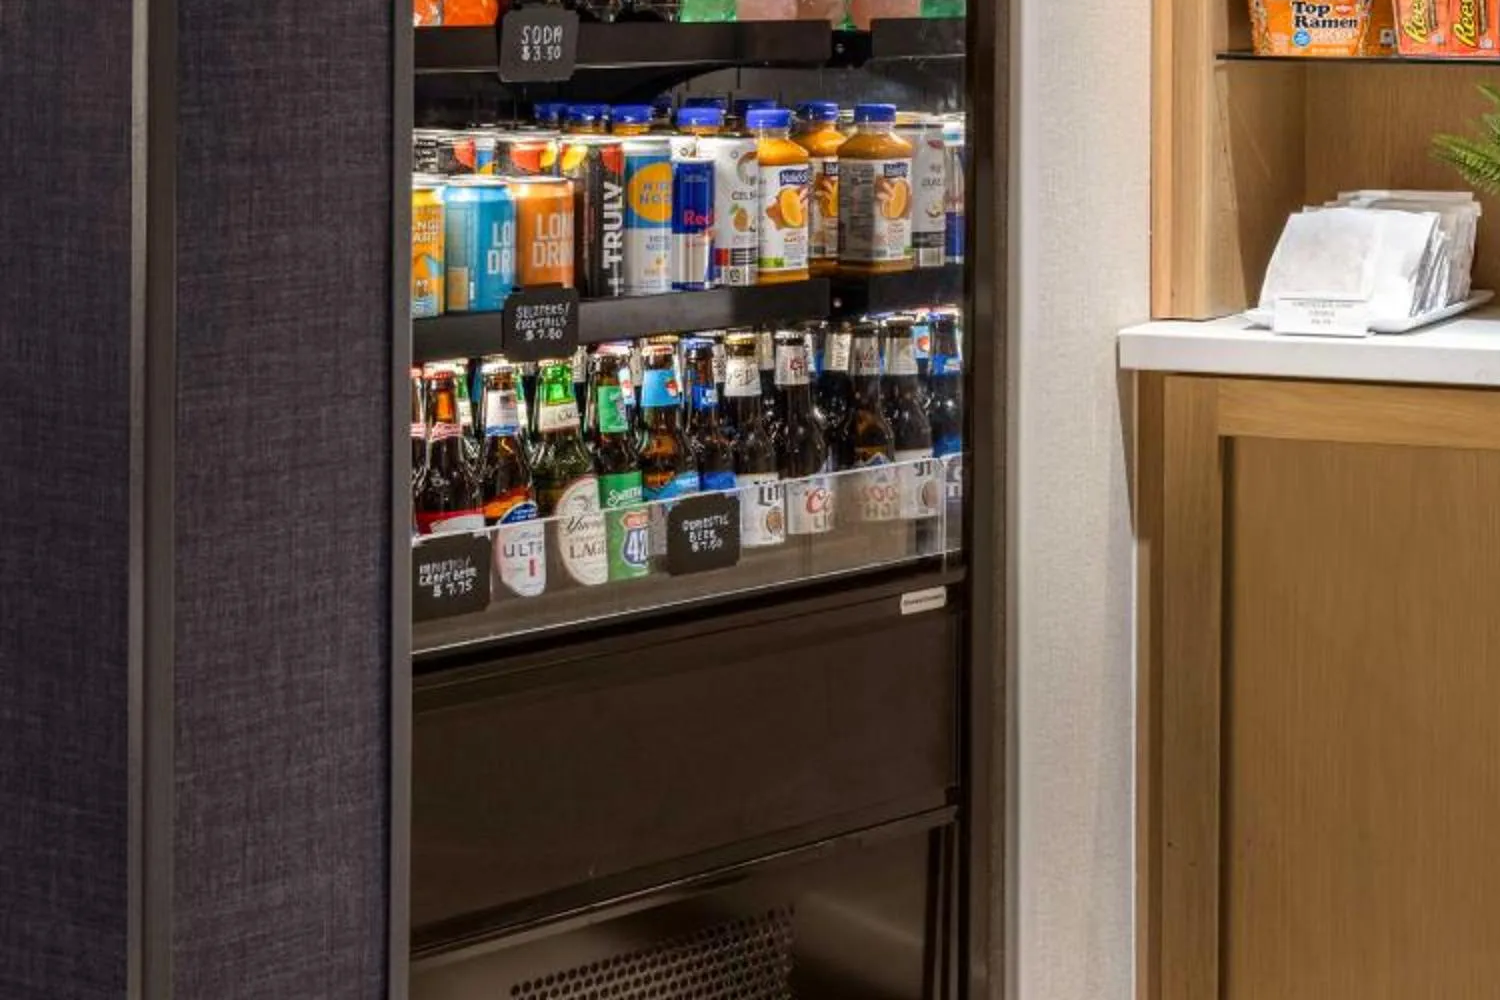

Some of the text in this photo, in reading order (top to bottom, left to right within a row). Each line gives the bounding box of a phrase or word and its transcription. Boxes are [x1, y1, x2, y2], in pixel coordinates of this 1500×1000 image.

[1292, 1, 1331, 16] Top
[1293, 15, 1359, 29] Ramen
[520, 25, 563, 45] SODA
[602, 181, 624, 270] TRULY
